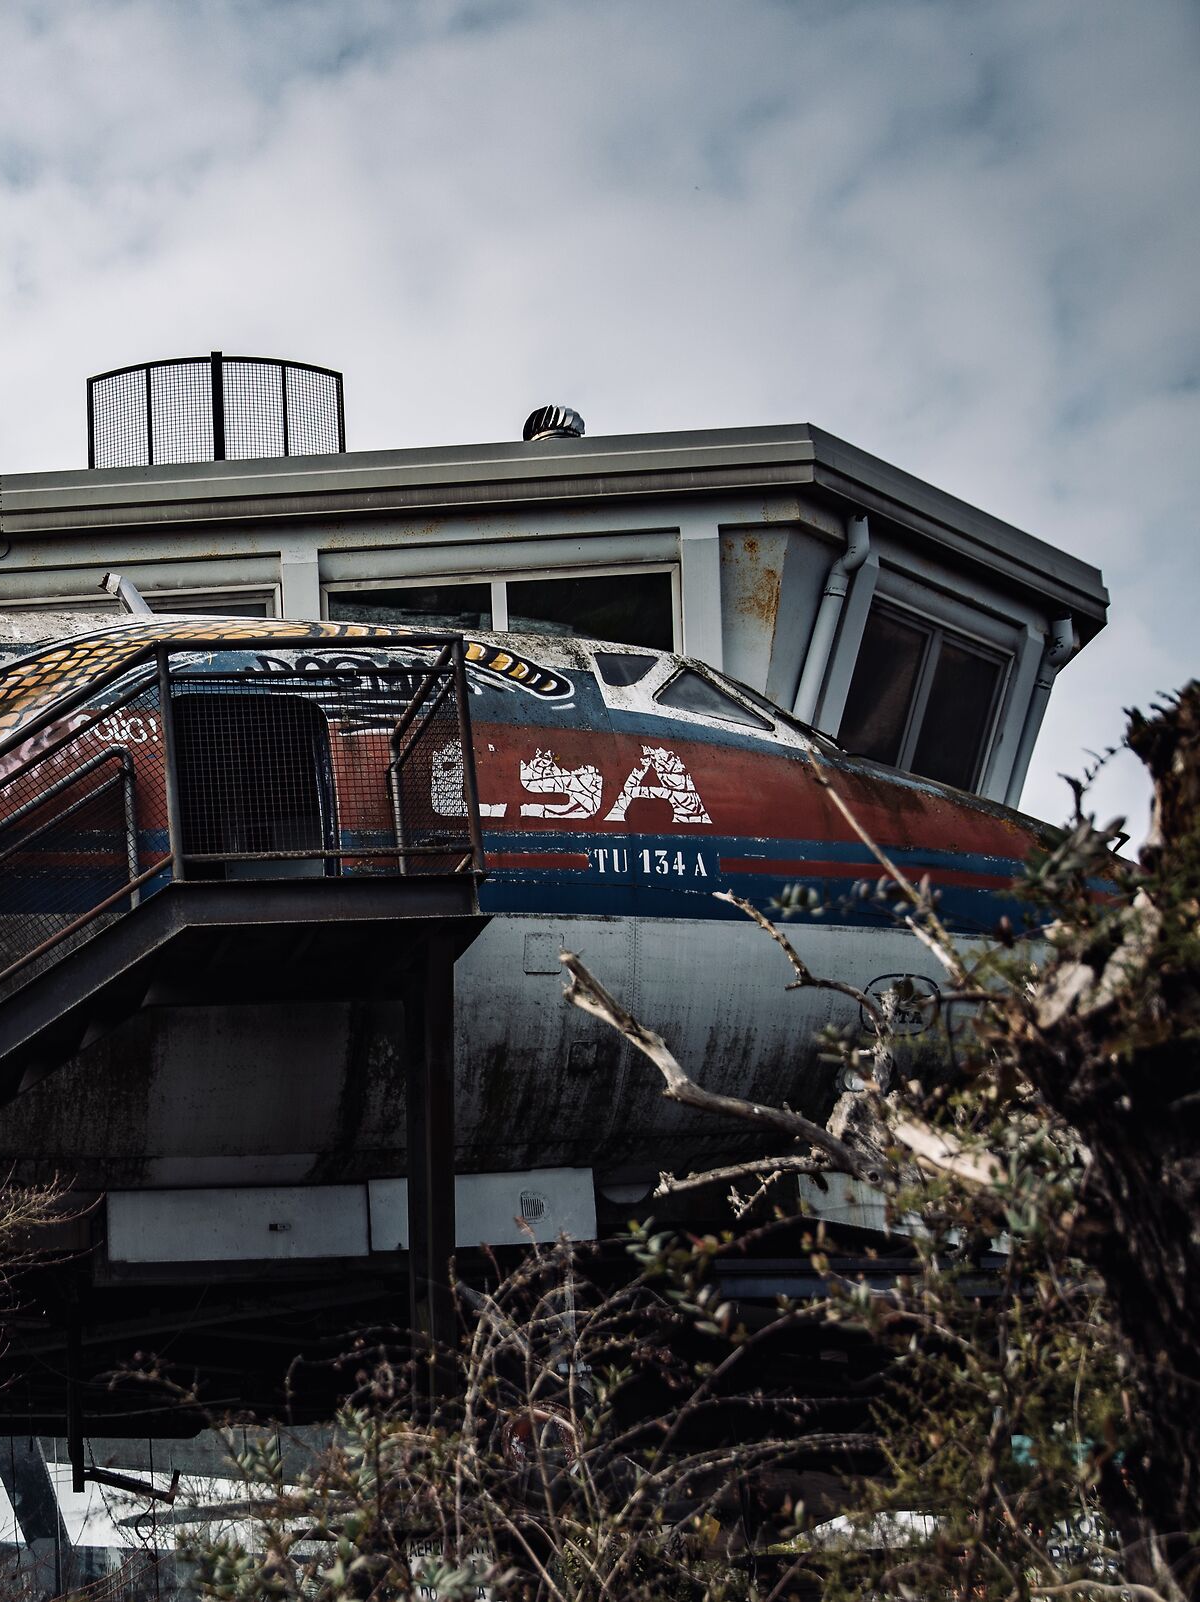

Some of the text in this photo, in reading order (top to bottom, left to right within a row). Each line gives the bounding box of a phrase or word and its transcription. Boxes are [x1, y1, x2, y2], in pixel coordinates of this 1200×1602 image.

[594, 848, 708, 877] TU 134 A
